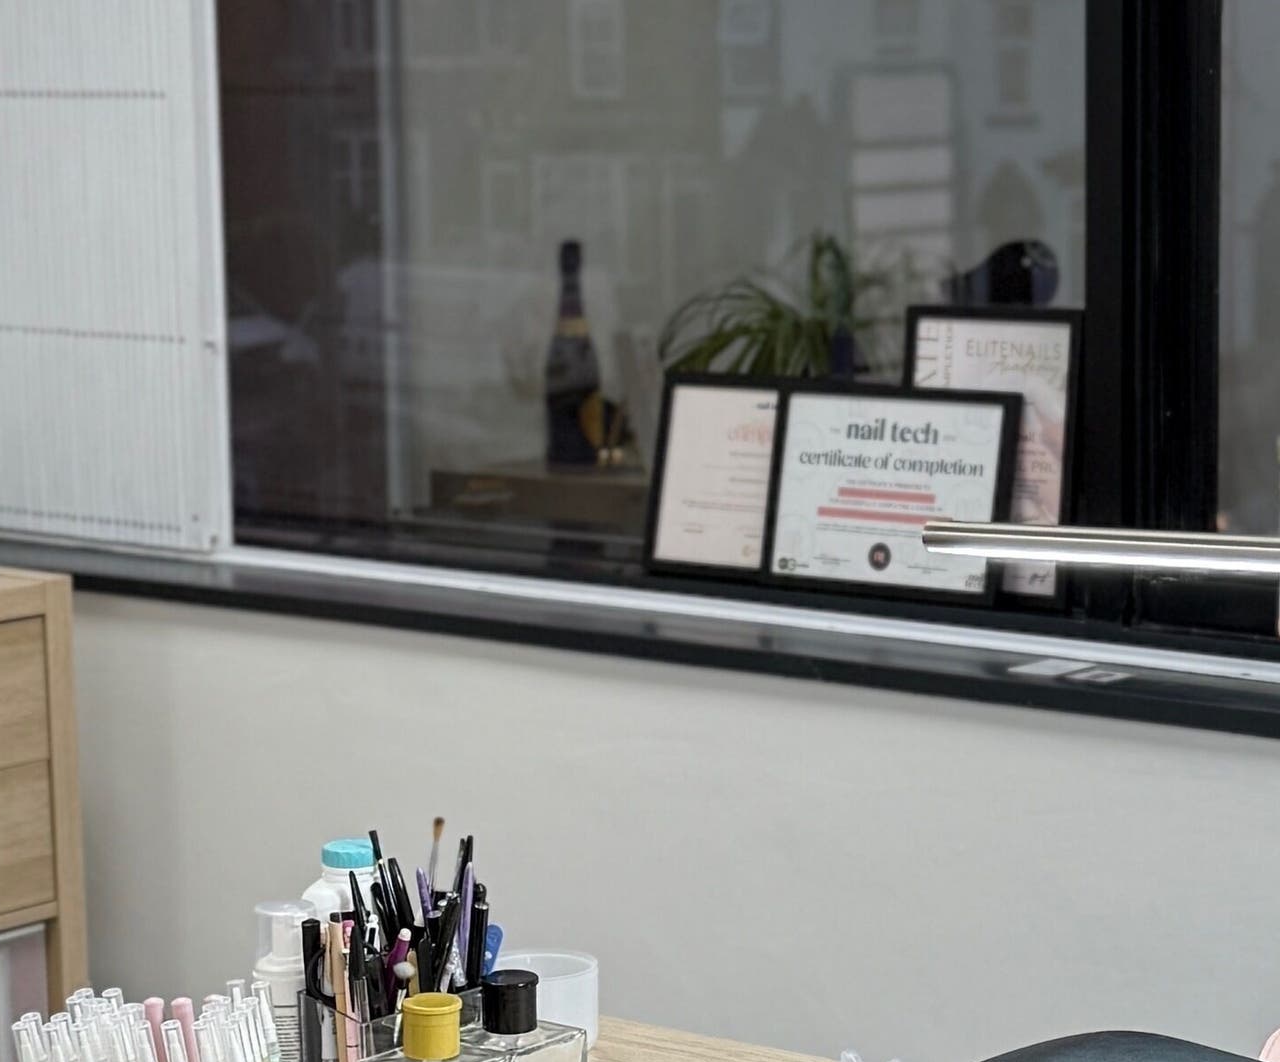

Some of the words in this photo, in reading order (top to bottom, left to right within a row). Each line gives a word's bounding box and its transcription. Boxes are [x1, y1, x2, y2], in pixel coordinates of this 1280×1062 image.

[966, 339, 1062, 361] ELITENAILS
[846, 418, 886, 441] nail
[890, 421, 940, 445] tech
[799, 449, 872, 469] certificate
[874, 453, 892, 470] of
[893, 459, 984, 477] completion
